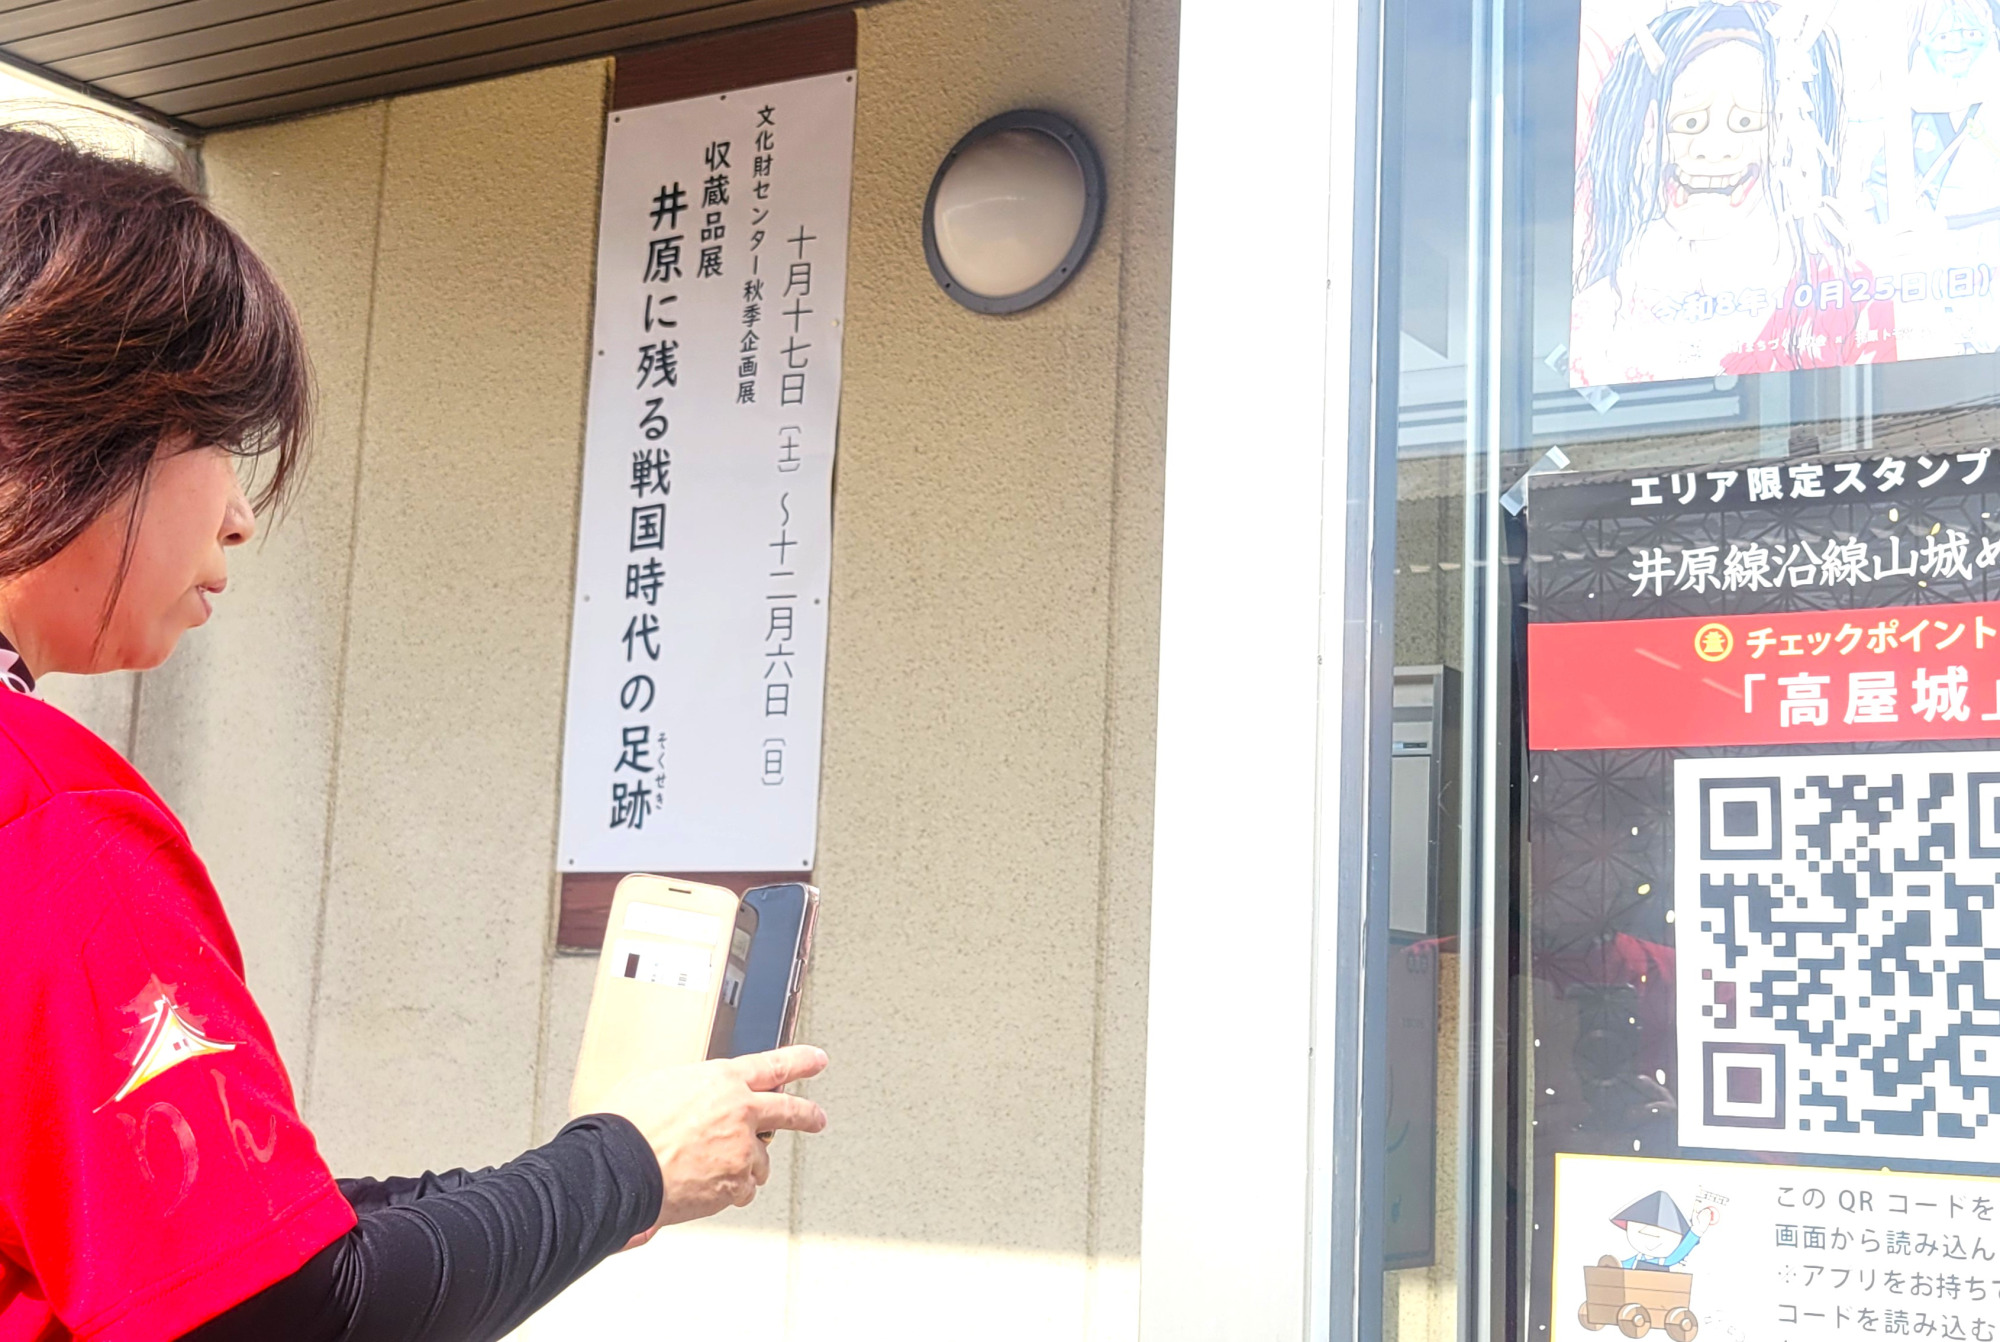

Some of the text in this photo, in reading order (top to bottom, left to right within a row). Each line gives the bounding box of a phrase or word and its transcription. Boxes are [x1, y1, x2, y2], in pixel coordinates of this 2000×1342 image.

[697, 141, 731, 279] 収蔵品展
[737, 105, 776, 404] 文化財センター秋季企画展
[609, 182, 688, 830] 井原に残る戦国時代の足跡
[1630, 447, 1991, 506] エリア限定スタンプ
[1746, 616, 1997, 659] チェックポイント
[655, 732, 667, 810] そくせき
[1775, 1223, 1996, 1262] 画面から読み込ん
[1777, 1303, 1996, 1342] コードを読み込む
